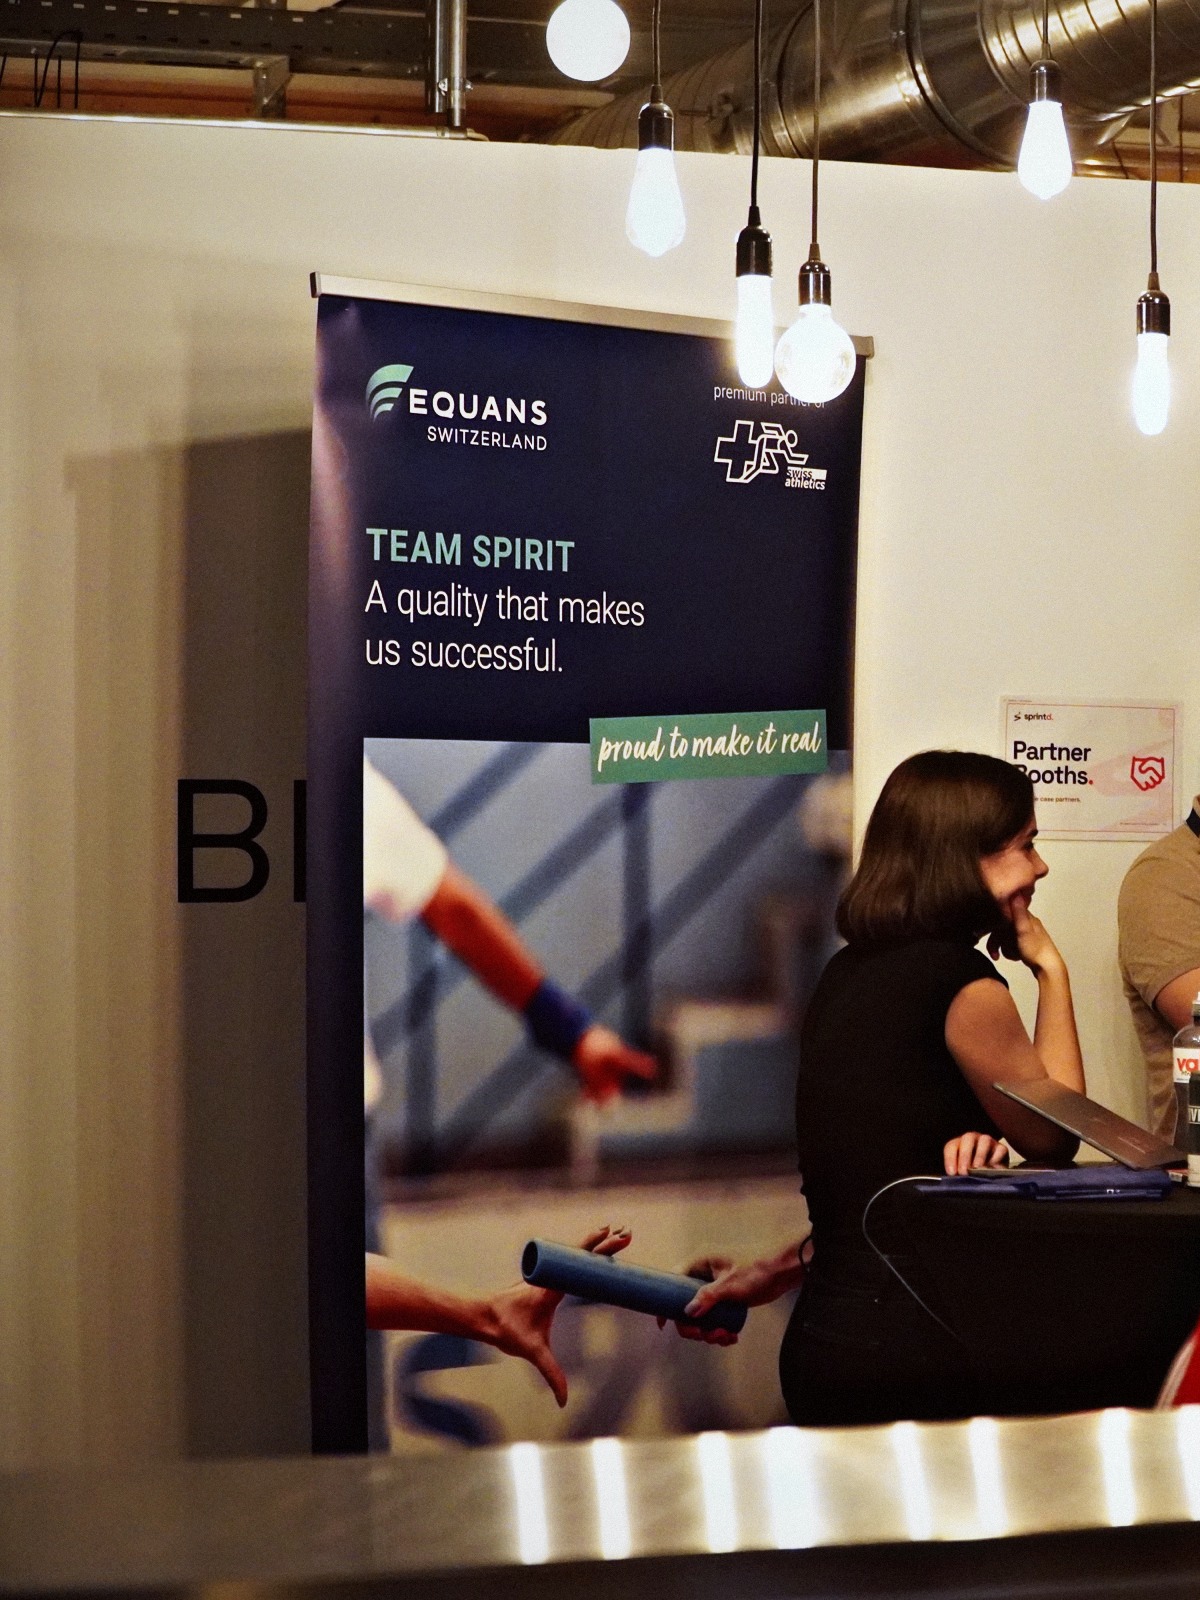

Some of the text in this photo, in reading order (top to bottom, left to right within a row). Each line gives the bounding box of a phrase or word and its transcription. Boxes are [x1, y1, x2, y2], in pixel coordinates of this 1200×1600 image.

[409, 388, 548, 426] EQUANS
[713, 386, 767, 402] premium
[427, 425, 548, 451] SWITZERLAND
[784, 475, 826, 490] athletics
[787, 466, 813, 479] swiss
[365, 527, 576, 572] TEAM SPIRIT
[364, 579, 645, 627] A quality that makes
[365, 636, 563, 673] us successful.
[597, 721, 822, 772] proud to make it real
[1013, 740, 1092, 762] Partner
